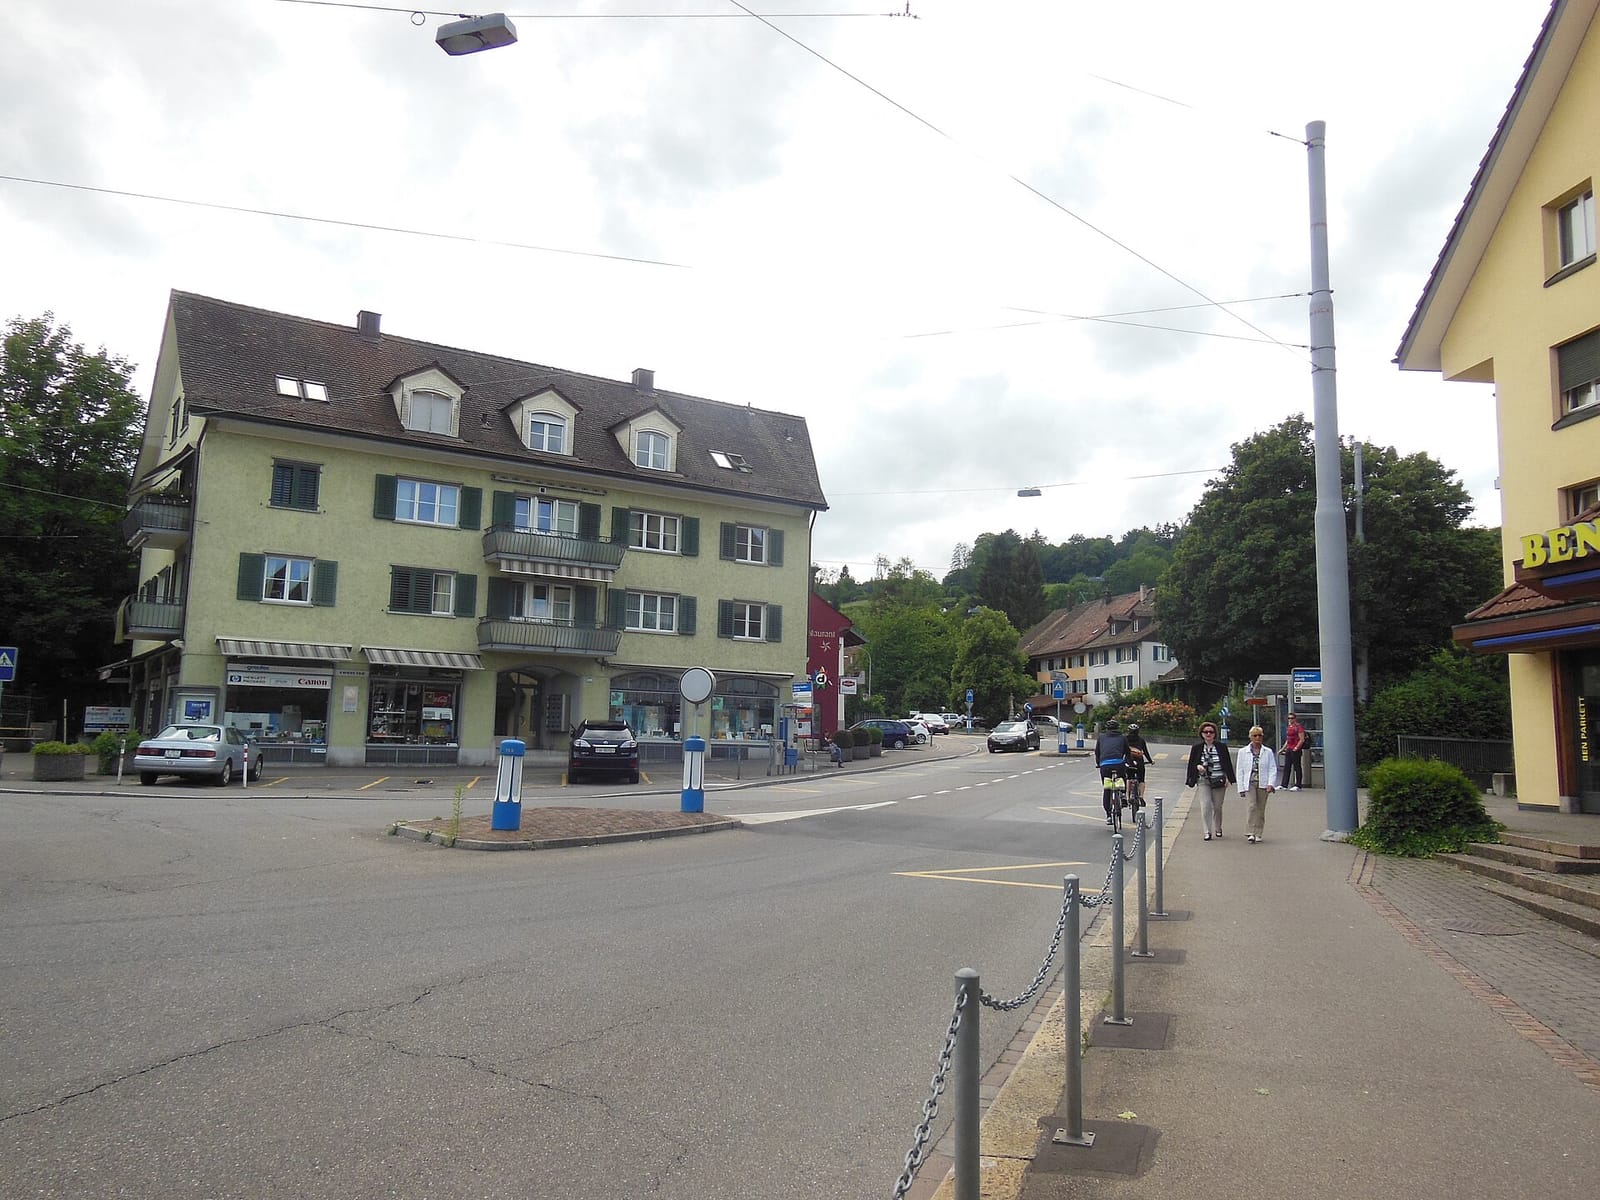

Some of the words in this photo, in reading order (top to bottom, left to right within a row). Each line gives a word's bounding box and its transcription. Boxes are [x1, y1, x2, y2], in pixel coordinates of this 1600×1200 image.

[1520, 517, 1600, 569] BEN
[298, 678, 327, 686] Canon
[1578, 696, 1587, 739] PARKETT
[1581, 742, 1589, 762] BEN
